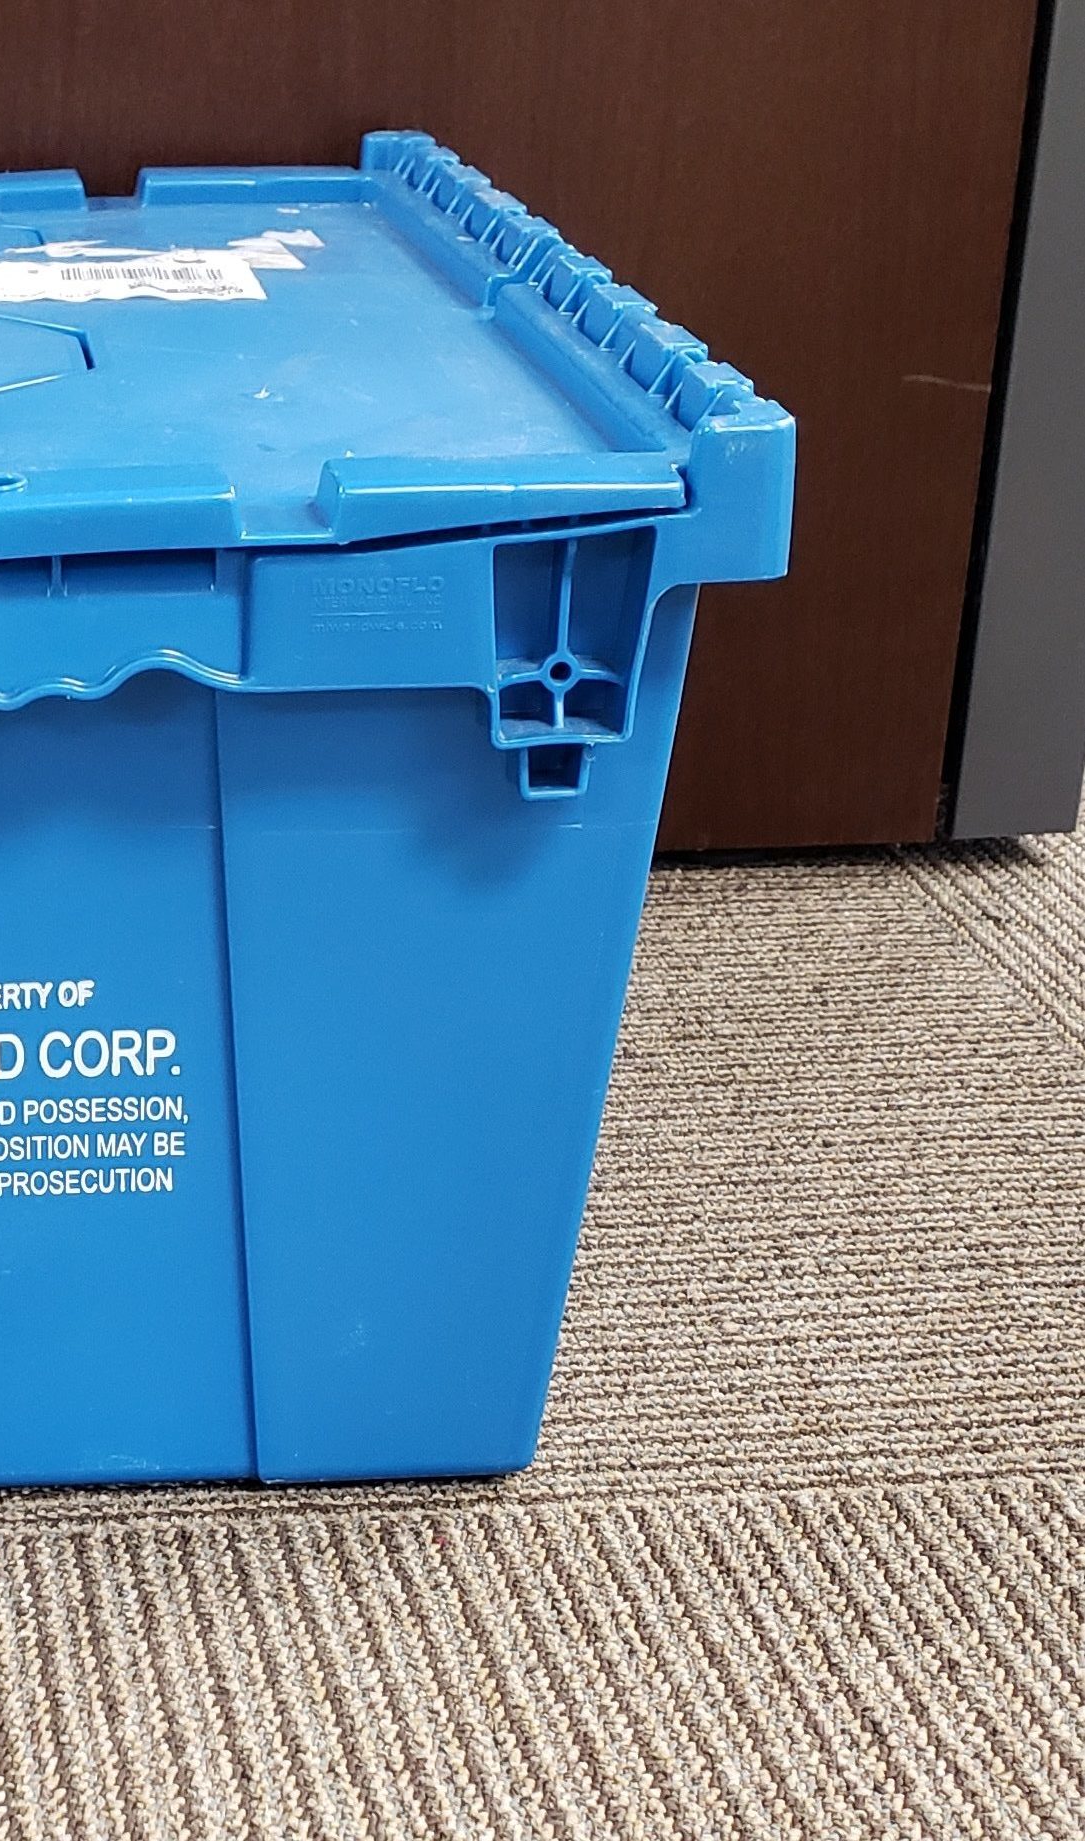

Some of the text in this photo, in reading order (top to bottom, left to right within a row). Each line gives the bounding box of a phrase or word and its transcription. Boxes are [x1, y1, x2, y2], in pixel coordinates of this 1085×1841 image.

[312, 575, 446, 596] MONOFLO
[57, 979, 95, 1008] OF
[39, 1029, 181, 1079] CORP.
[23, 1096, 190, 1125] POSSESSION,
[96, 1132, 148, 1158] MAY
[153, 1131, 186, 1156] BE
